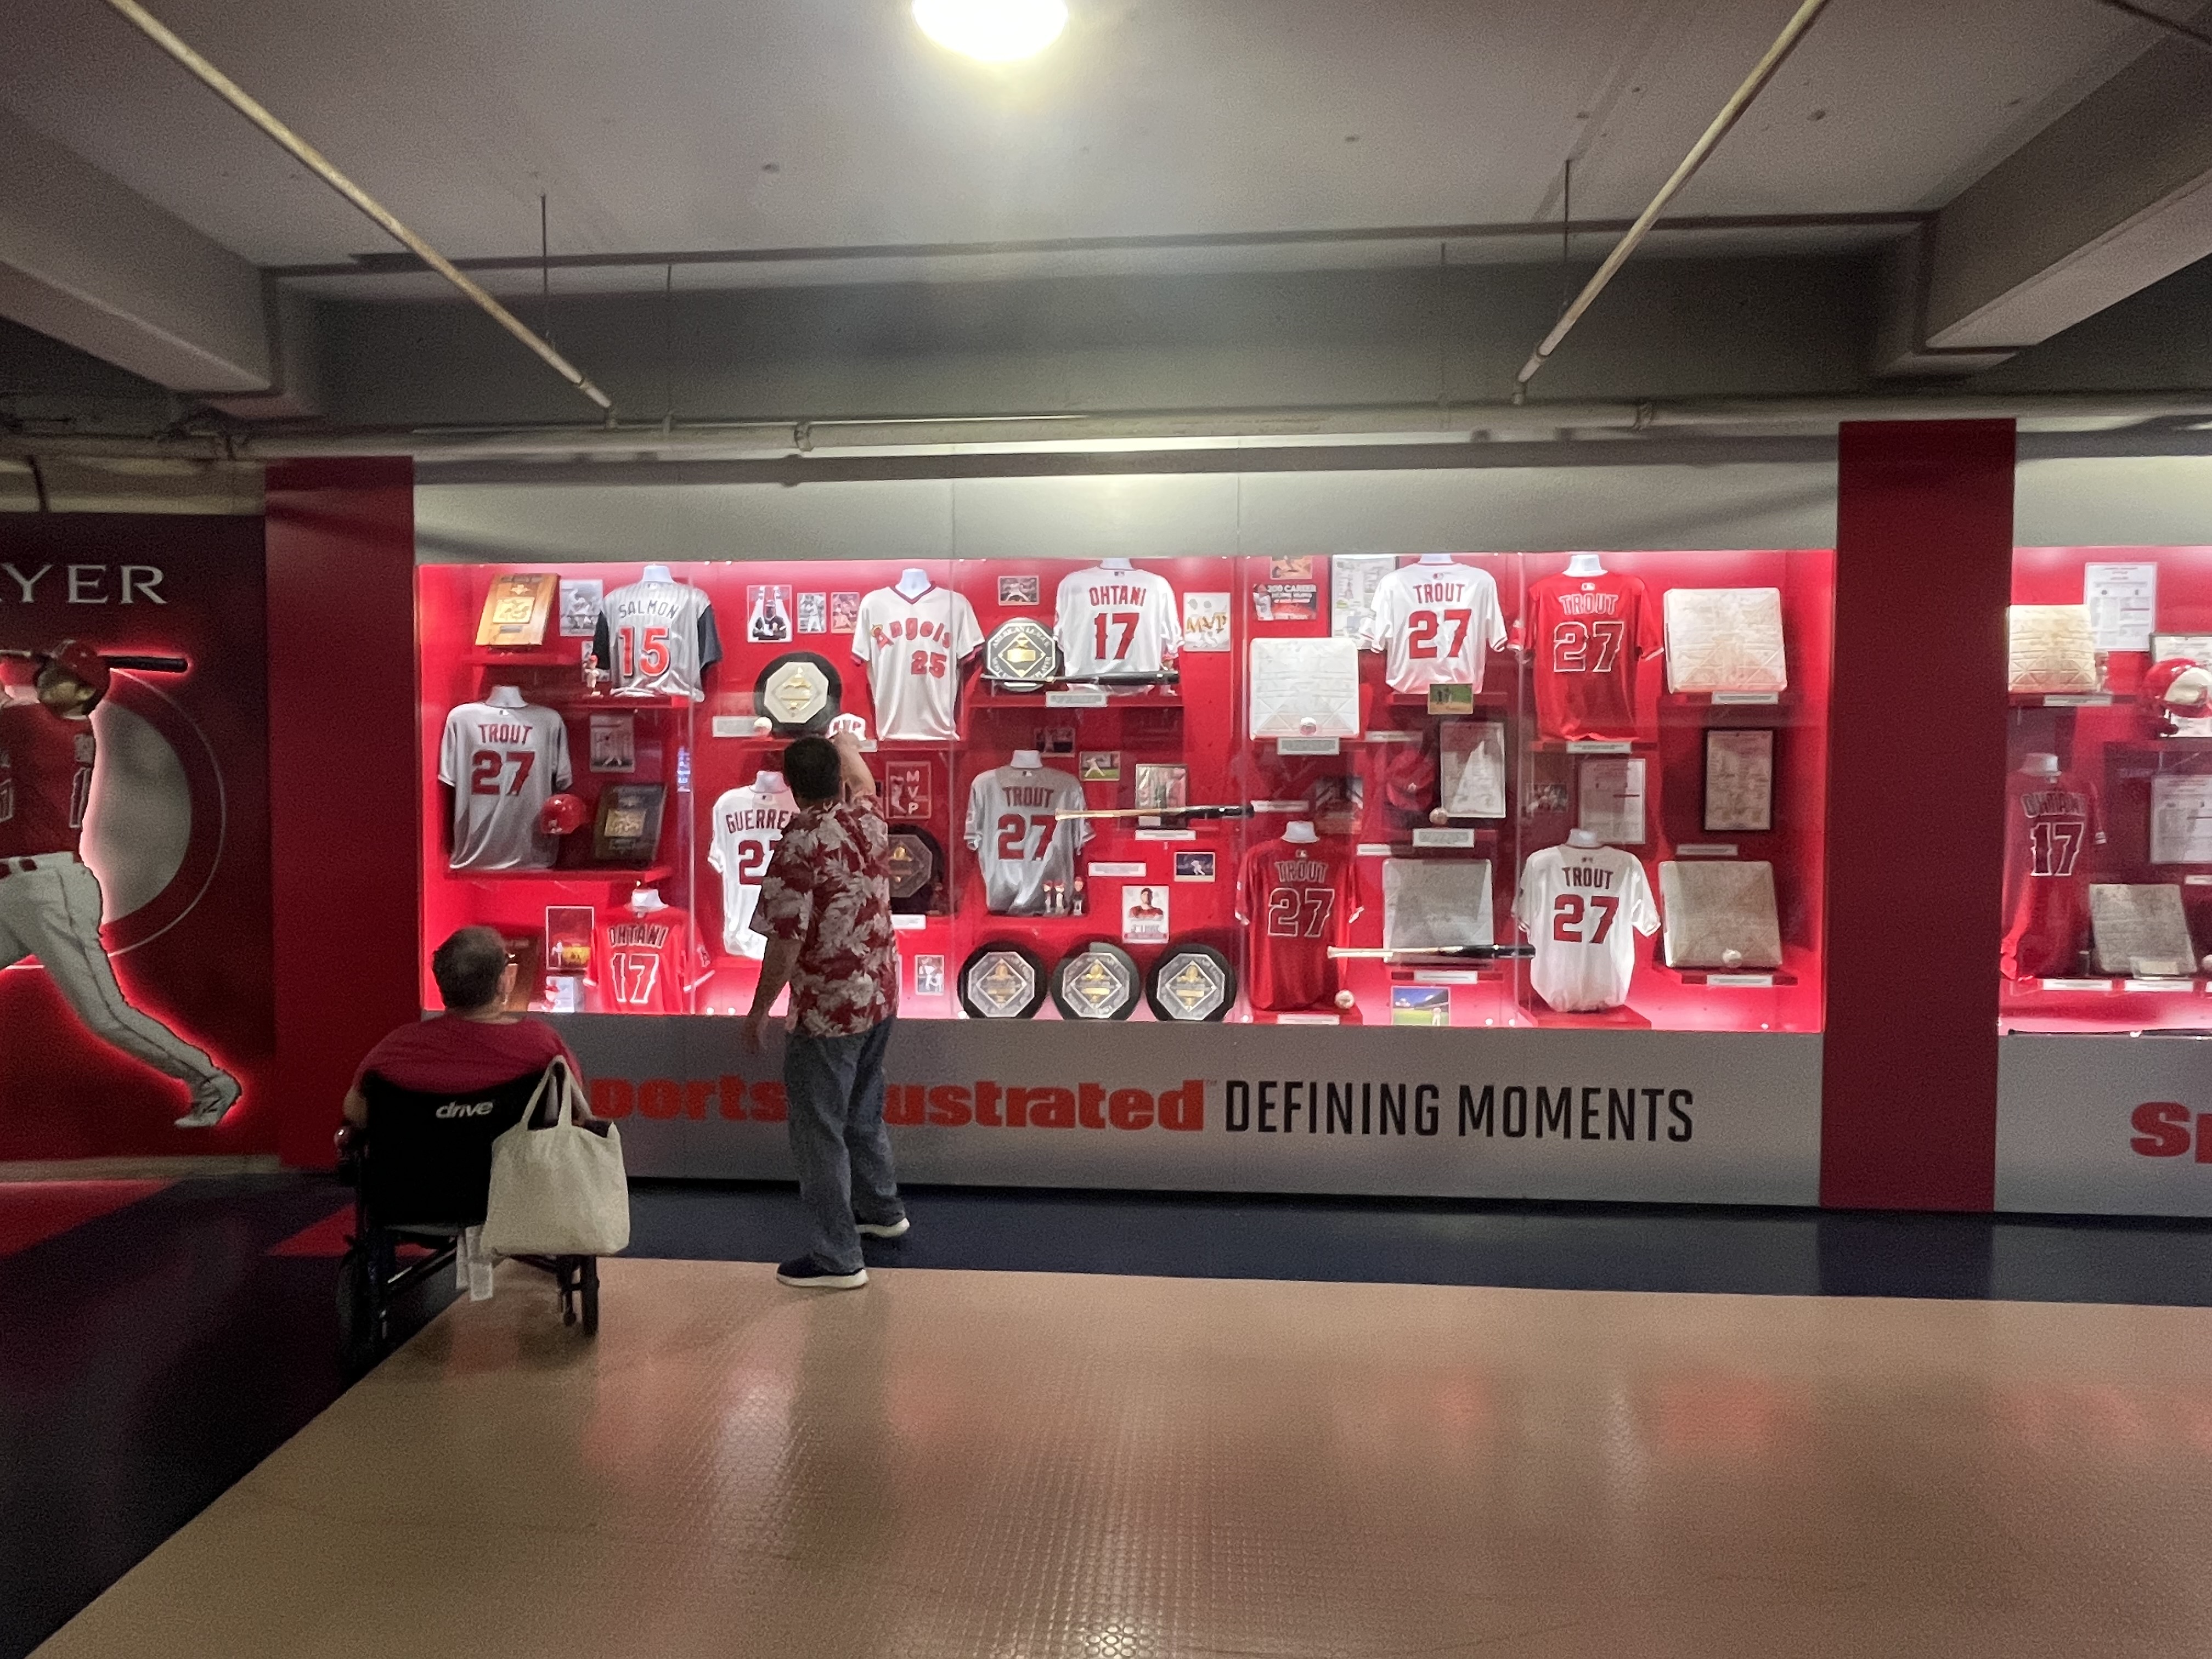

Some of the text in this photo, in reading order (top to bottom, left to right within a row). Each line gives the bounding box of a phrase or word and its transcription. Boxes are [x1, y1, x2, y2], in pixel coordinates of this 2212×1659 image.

[0, 563, 168, 604] YER
[1089, 585, 1147, 607] OHTANI
[1414, 583, 1465, 604] TROUT
[619, 601, 679, 618] SALMON
[1559, 592, 1619, 615] TROUT
[872, 618, 951, 650] Angels
[1094, 612, 1140, 660] 17
[1186, 612, 1227, 634] MVP
[1408, 609, 1471, 659] 27
[619, 625, 670, 677] 15
[911, 650, 947, 679] 25
[1554, 621, 1624, 673] 27
[478, 724, 532, 744] TROUT
[471, 750, 535, 795] 27
[1003, 787, 1054, 807] TROUT
[725, 809, 795, 834] GUERRE
[997, 813, 1057, 861] 27
[738, 839, 780, 885] 2
[2030, 822, 2084, 876] 17
[1274, 860, 1328, 883] TROUT
[1561, 867, 1613, 890] TROUT
[1267, 888, 1335, 937] 27
[1554, 893, 1619, 944] 27
[611, 952, 659, 1004] 17
[436, 1101, 493, 1119] drive
[590, 1074, 1693, 1143] ports ustrated DEFINING MOMENTS
